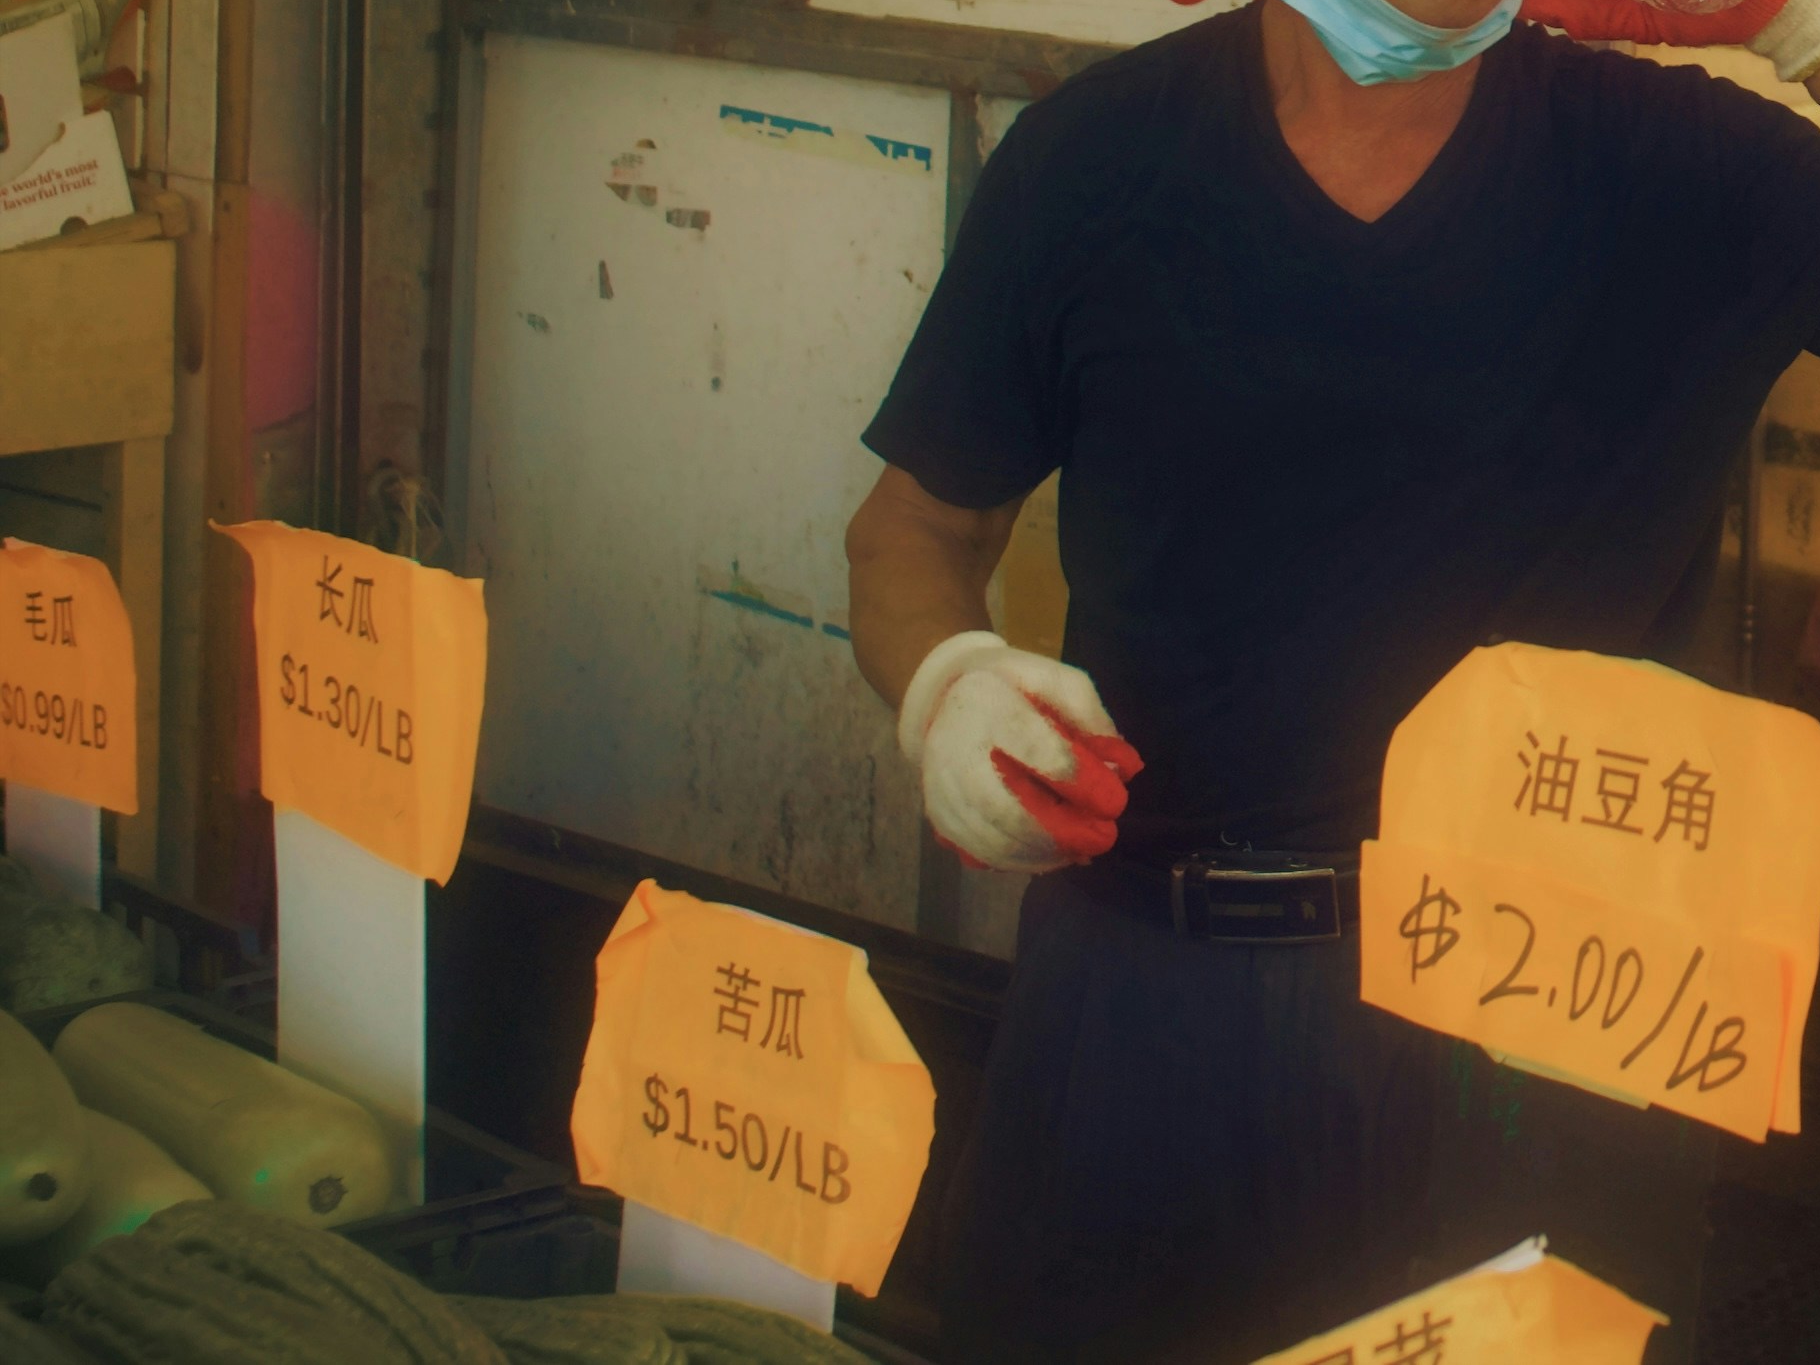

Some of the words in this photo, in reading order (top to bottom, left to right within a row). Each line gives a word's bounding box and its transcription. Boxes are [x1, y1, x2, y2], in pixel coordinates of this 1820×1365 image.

[24, 590, 77, 648] 毛瓜
[315, 554, 379, 644] 长瓜
[0, 681, 108, 751] $0.99/LB
[280, 652, 414, 765] $1.30/LB
[1513, 729, 1717, 853] 油豆角
[712, 961, 807, 1061] 苦瓜
[641, 1071, 853, 1206] $1.50/LB
